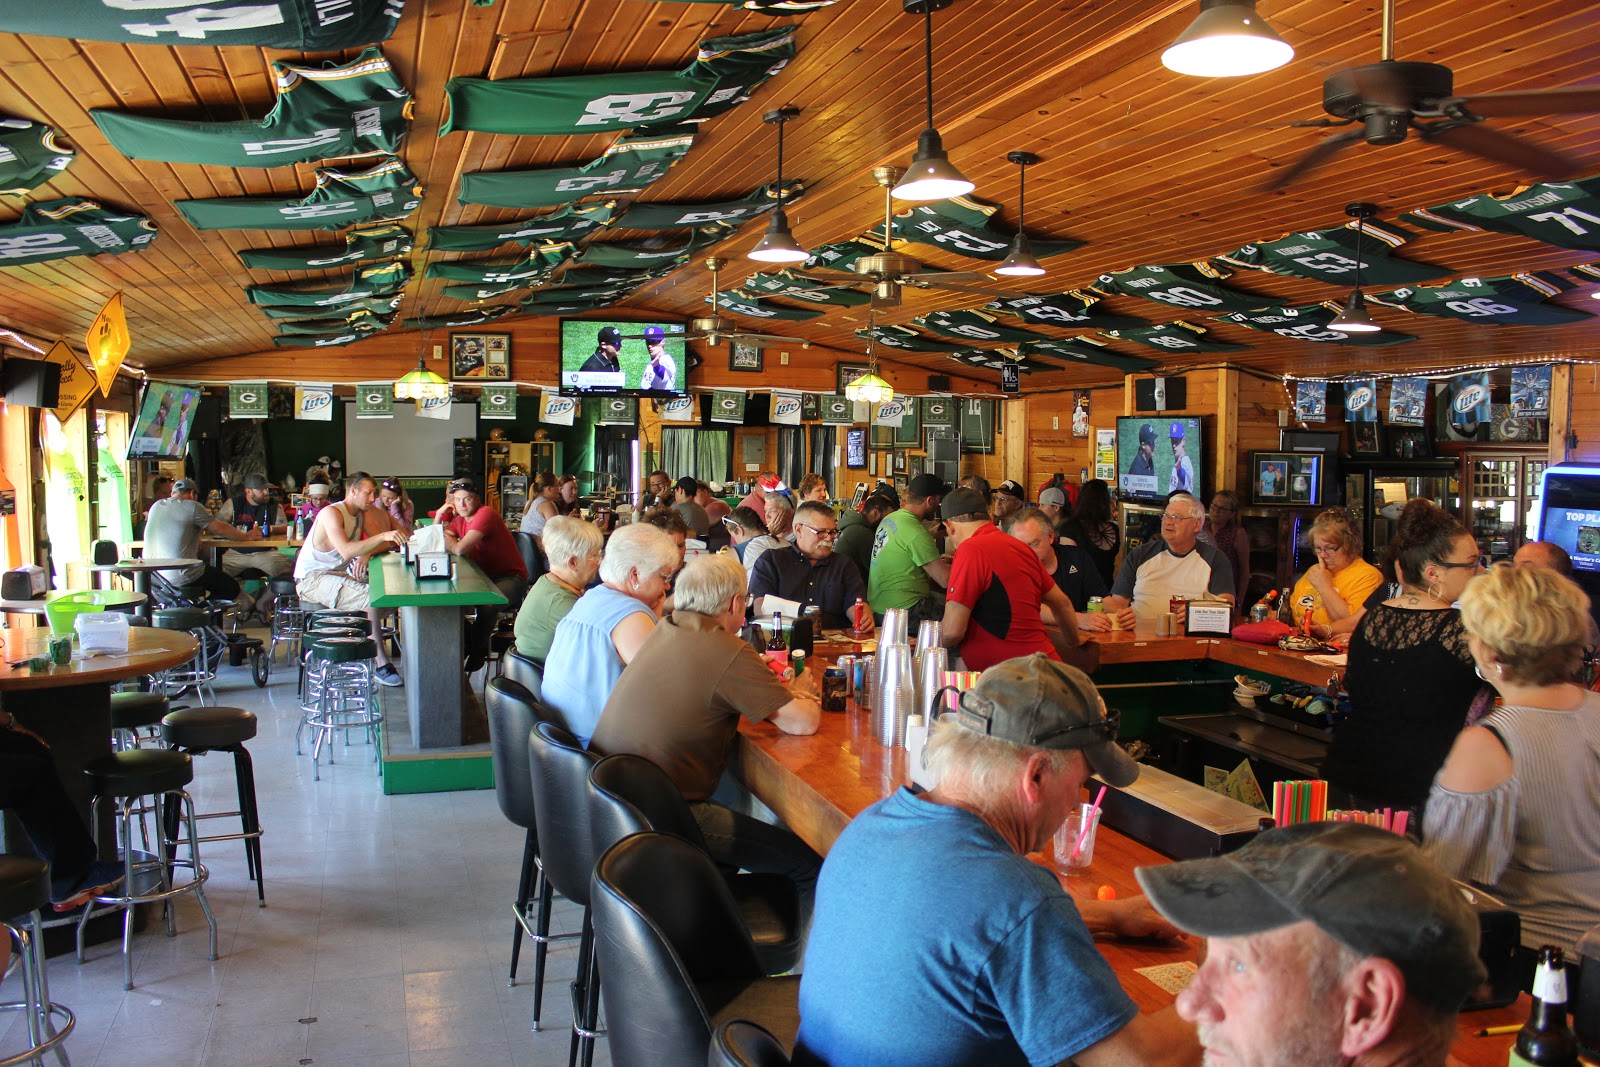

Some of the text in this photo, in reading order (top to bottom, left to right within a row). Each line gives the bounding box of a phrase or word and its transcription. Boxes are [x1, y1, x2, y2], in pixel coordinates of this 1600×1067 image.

[575, 90, 696, 127] 62
[1500, 190, 1564, 213] DOTSON
[1526, 206, 1600, 236] 71
[1292, 252, 1369, 274] 53
[1147, 286, 1224, 307] 80
[1445, 297, 1518, 317] 96
[304, 396, 328, 411] Lite
[424, 397, 447, 408] Lite
[547, 402, 571, 415] Lite
[666, 399, 688, 411] Lite
[1351, 393, 1369, 409] Lite
[1459, 391, 1481, 411] Lite
[776, 403, 797, 415] Lite
[879, 405, 900, 418] Lite
[1566, 511, 1600, 523] TOP PL
[430, 562, 438, 572] 6
